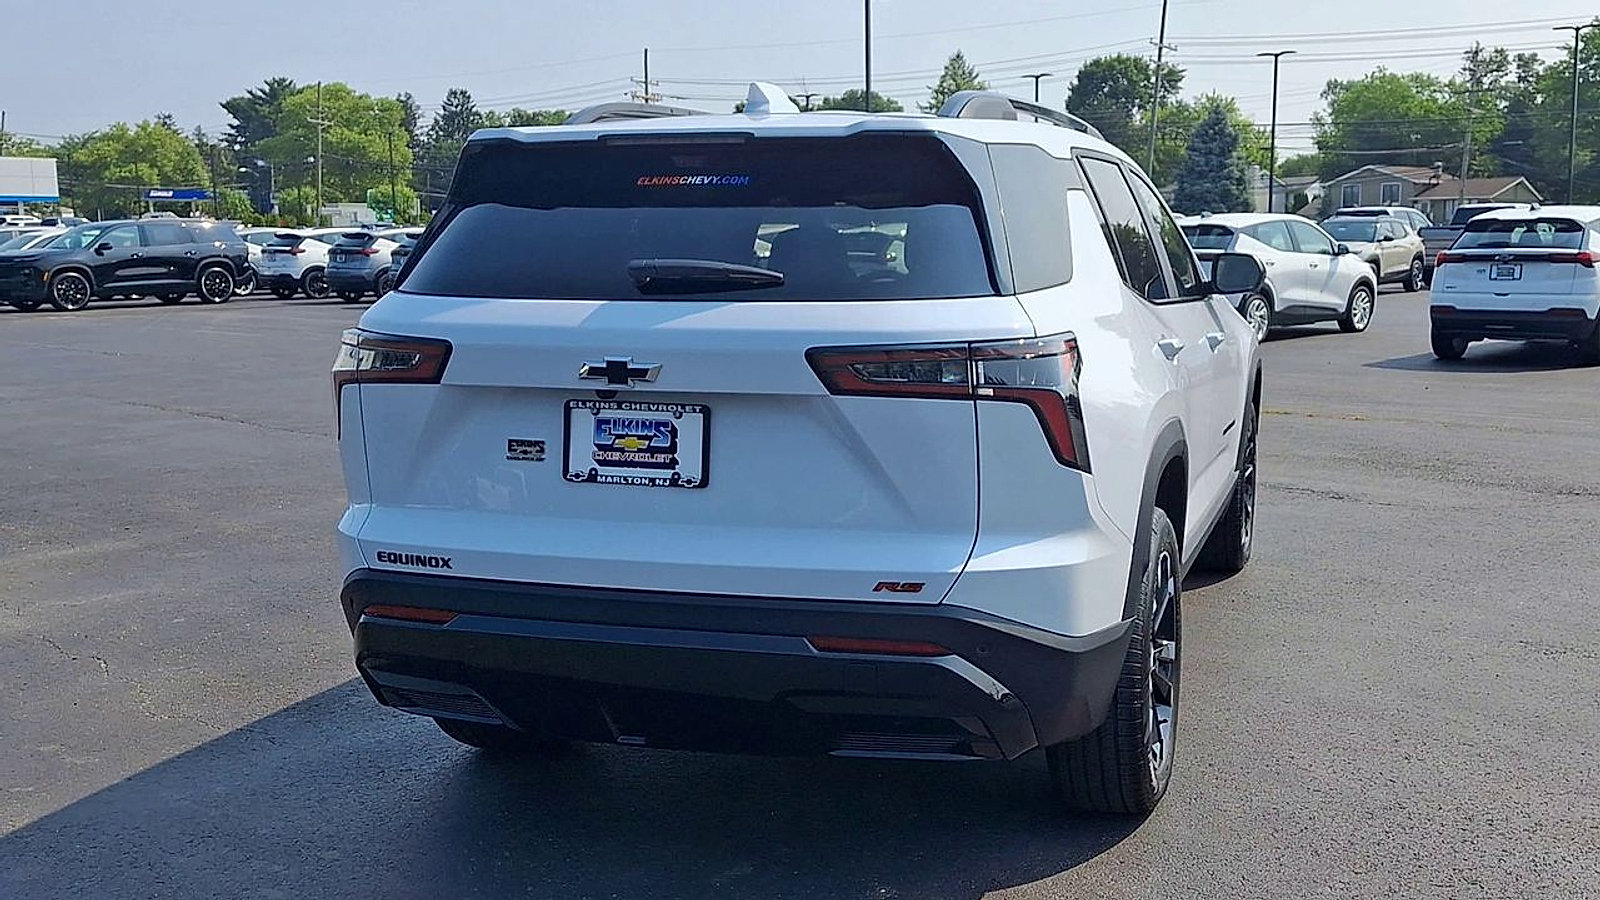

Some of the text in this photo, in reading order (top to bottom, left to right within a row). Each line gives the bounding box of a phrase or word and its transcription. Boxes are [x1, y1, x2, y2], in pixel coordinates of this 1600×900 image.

[637, 175, 749, 186] ELKINSCHEVY.COM
[569, 401, 703, 414] ELKINS CHEVROLET
[593, 417, 672, 446] ELKINS
[592, 450, 673, 463] CHEVROLET
[597, 475, 670, 487] MARLTON, NJ
[376, 550, 453, 570] EQUINOX
[872, 581, 926, 593] RS
